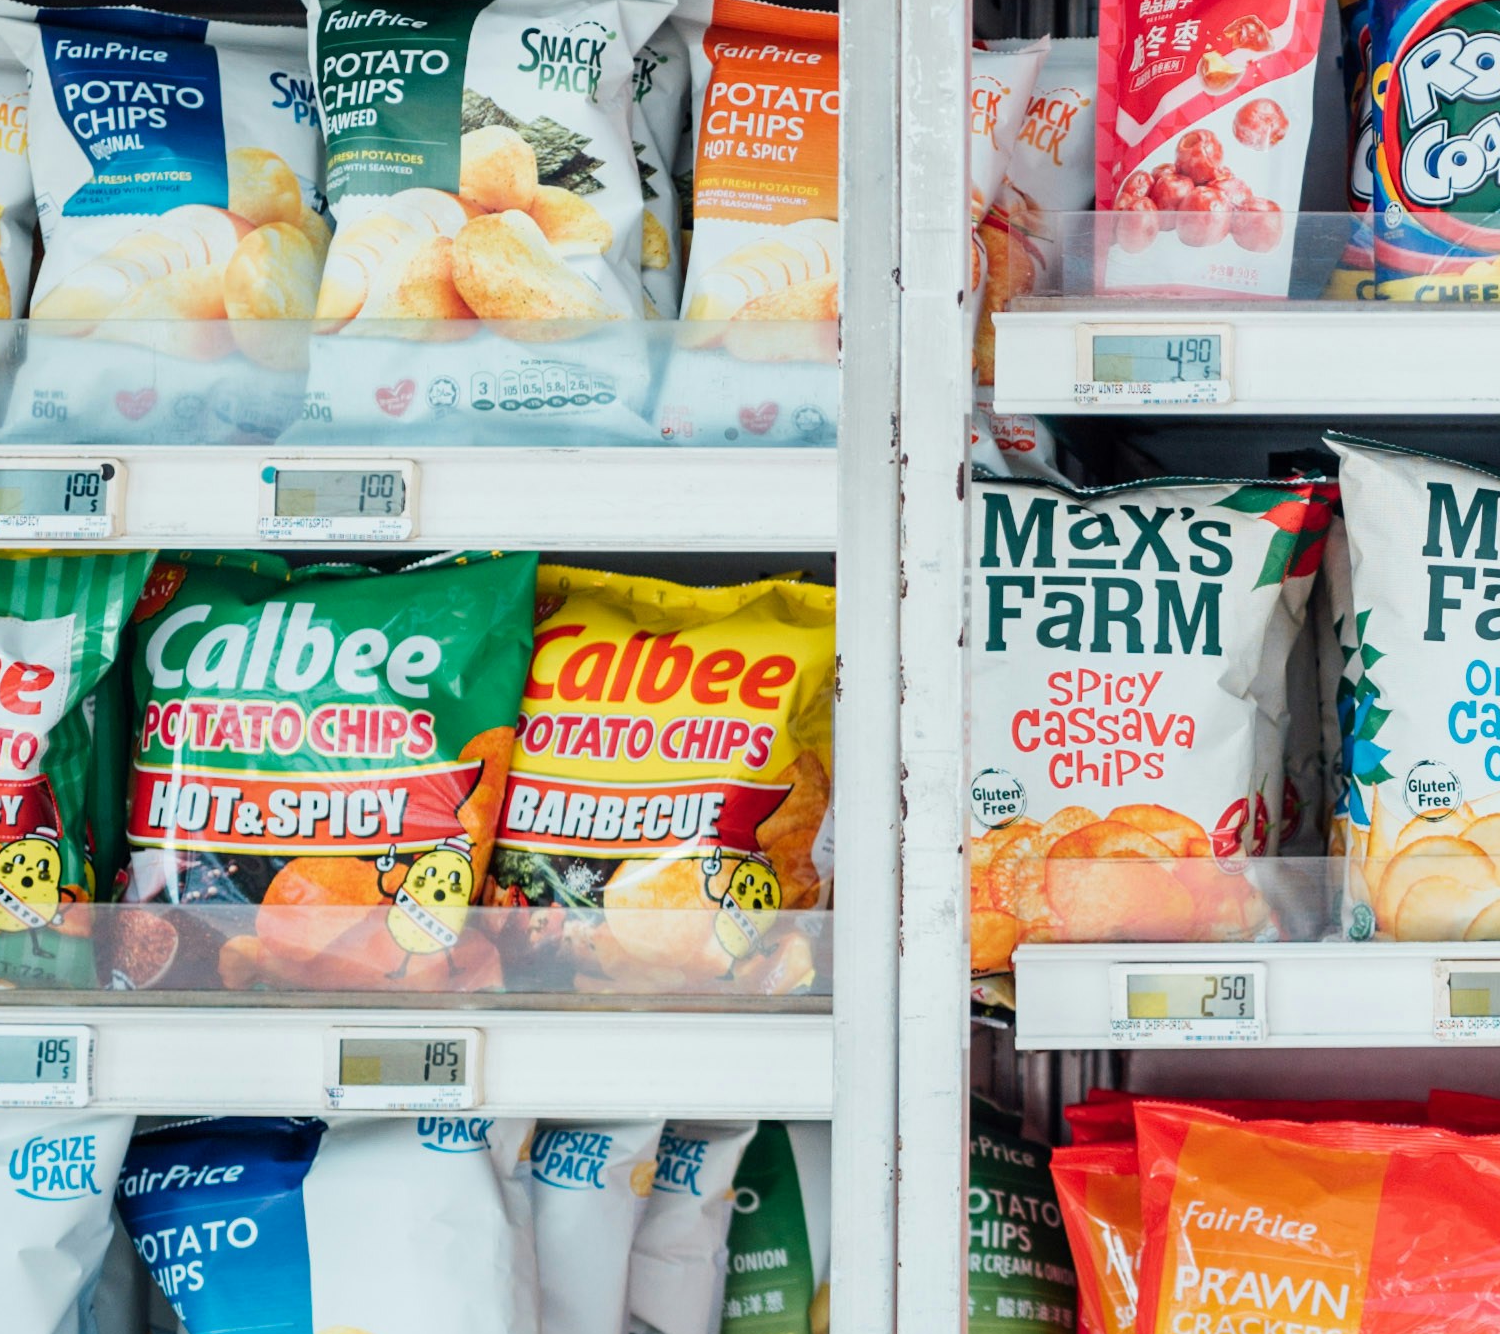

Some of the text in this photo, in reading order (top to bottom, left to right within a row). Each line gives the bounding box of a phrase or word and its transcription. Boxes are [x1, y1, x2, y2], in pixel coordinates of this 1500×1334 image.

[324, 8, 428, 33] FairPrice
[32, 398, 68, 423] 60g
[147, 602, 442, 699] Calbee
[141, 701, 435, 758] POTATO CHIPS
[508, 787, 725, 839] BARBECUE
[972, 787, 1021, 808] Gluten
[983, 801, 1016, 816] Free
[9, 1135, 97, 1181] UPSIZE
[32, 1163, 101, 1193] PACK
[1183, 1201, 1318, 1241] FairPrice
[734, 1248, 788, 1273] ONION
[1173, 1267, 1350, 1322] PRAWN
